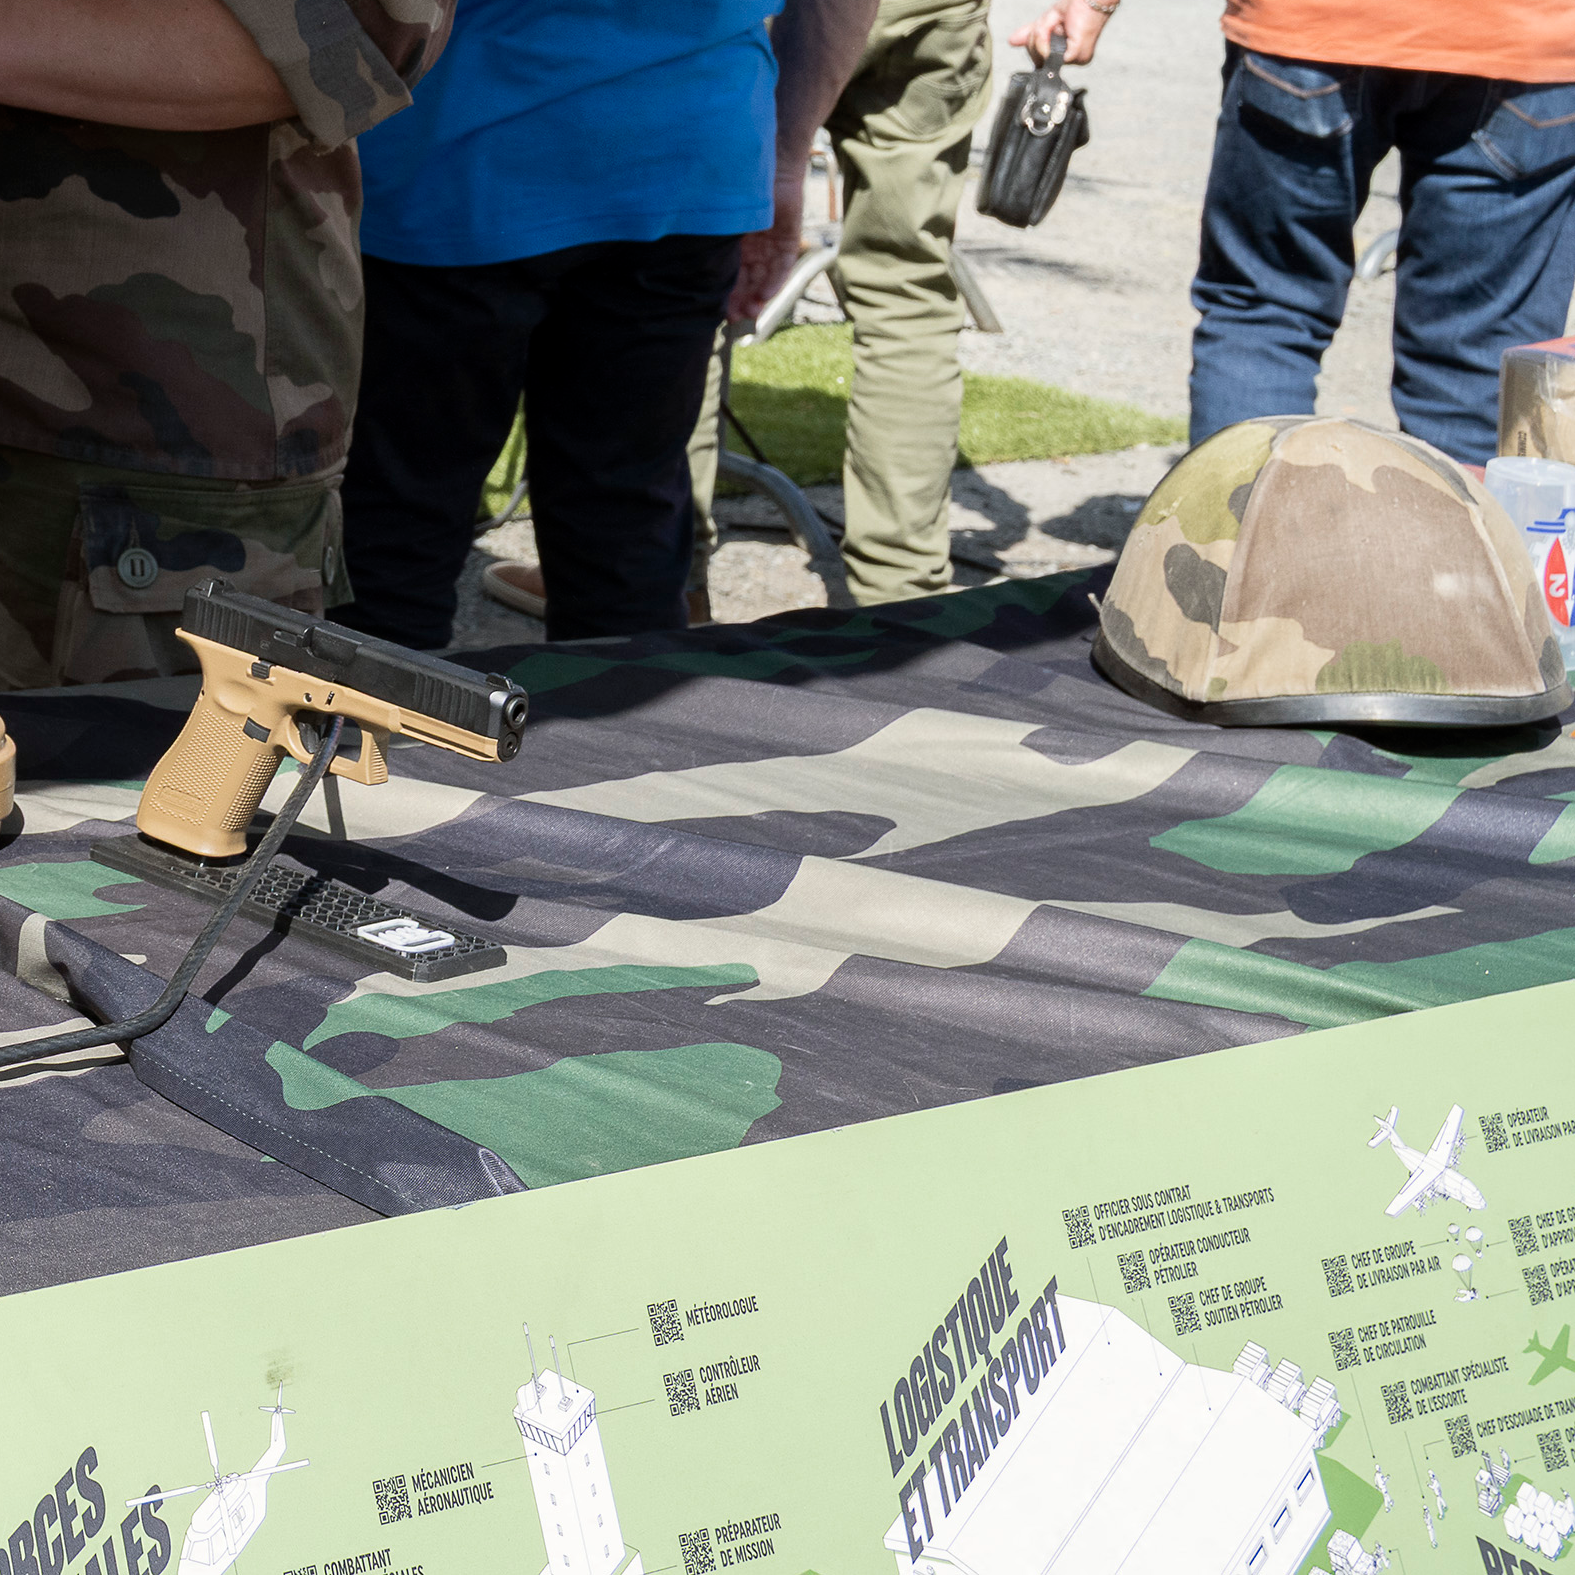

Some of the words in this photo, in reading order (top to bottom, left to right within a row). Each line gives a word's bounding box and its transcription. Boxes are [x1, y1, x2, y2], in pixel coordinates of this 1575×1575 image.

[1506, 1106, 1549, 1128] OPÉRATEUR
[1512, 1131, 1524, 1147] DE
[1523, 1123, 1562, 1145] LIVRAISON
[1093, 1200, 1131, 1221] OFFICIER
[1132, 1193, 1154, 1212] SOUS
[1154, 1184, 1191, 1207] CONTRAT
[1099, 1212, 1166, 1241] D'ENCADREMENT
[1167, 1202, 1214, 1228] LOGISTIQUE
[1215, 1199, 1222, 1214] &
[1222, 1187, 1275, 1212] TRANSPORTS
[1535, 1211, 1556, 1229] CHEF
[1555, 1209, 1567, 1225] DE
[1148, 1242, 1197, 1264] OPÉRATEUR
[1197, 1227, 1251, 1253] CONDUCTEUR
[1351, 1251, 1371, 1269] CHEF
[1373, 1248, 1384, 1264] DE
[1384, 1240, 1416, 1262] GROUPE
[1153, 1261, 1199, 1285] PÉTROLIER
[1356, 1273, 1369, 1290] DE
[1369, 1263, 1410, 1286] LIVRAISON
[1410, 1259, 1426, 1276] PAR
[1426, 1255, 1442, 1272] AIR
[1198, 1288, 1220, 1306] CHEF
[1222, 1284, 1233, 1301] DE
[1234, 1276, 1267, 1298] GROUPE
[685, 1295, 759, 1327] MÉTÉOROLOGUE
[1204, 1304, 1239, 1327] SOUTIEN
[1240, 1294, 1284, 1318] PÉTROLIER
[1357, 1323, 1378, 1343] CHEF
[1379, 1320, 1390, 1337] DE
[1391, 1310, 1437, 1334] PATROUILLE
[879, 1235, 1020, 1479] LOGISTIQUE
[1363, 1346, 1376, 1363] DE
[1376, 1333, 1427, 1360] CIRCULATION
[699, 1354, 761, 1384] CONTRÔLEUR
[1410, 1368, 1461, 1395] COMBATTANT
[1461, 1356, 1509, 1383] SPÉCIALISTE
[705, 1382, 739, 1406] AÉRIEN
[1416, 1399, 1428, 1416] DE
[1429, 1389, 1468, 1413] L'ESCORTE
[898, 1459, 934, 1565] ET
[928, 1274, 1066, 1518] TRANSPORT
[1476, 1420, 1496, 1438] CHEF
[1499, 1406, 1544, 1432] D'ESCOUADE
[1543, 1403, 1555, 1419] DE
[411, 1462, 475, 1493] MÉCANICIEN
[417, 1481, 494, 1517] AÉRONAUTIQUE
[715, 1513, 782, 1545] PRÉPARATEUR
[720, 1549, 734, 1567] DE
[734, 1538, 775, 1565] MISSION
